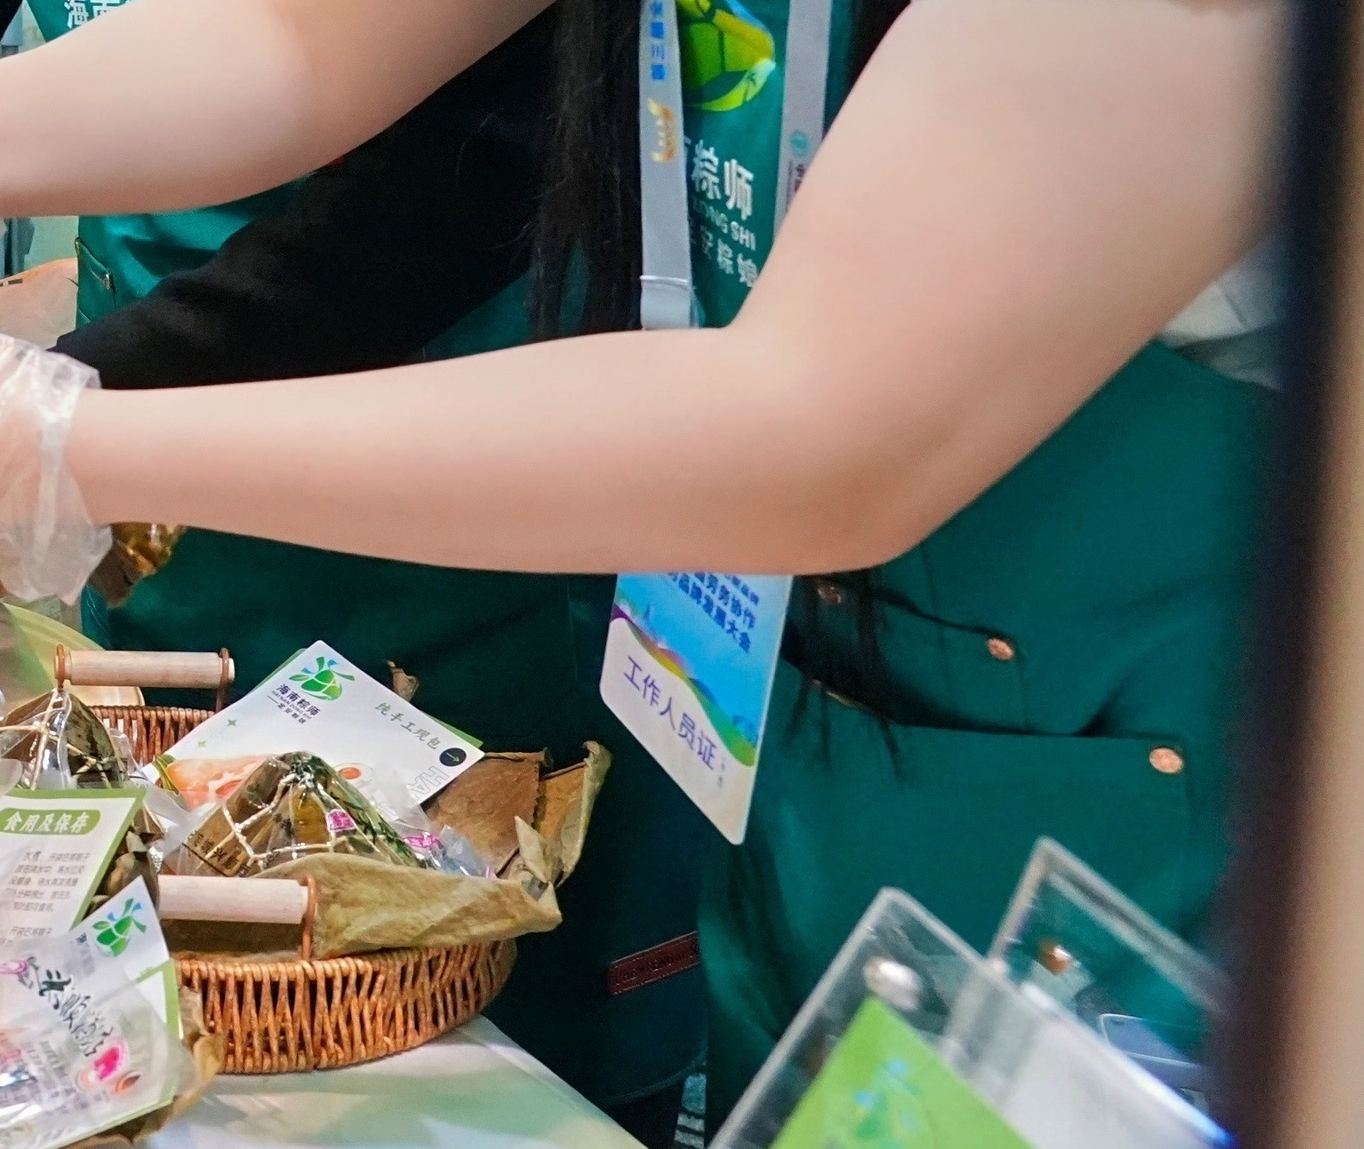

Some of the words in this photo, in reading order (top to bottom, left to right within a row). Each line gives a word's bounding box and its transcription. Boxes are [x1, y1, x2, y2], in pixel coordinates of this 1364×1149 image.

[731, 221, 756, 250] SHI
[276, 684, 321, 716] 海南粽师
[623, 656, 718, 770] 工作人员证
[375, 702, 441, 750] 纯手工现包
[4, 811, 89, 833] 食用及保存
